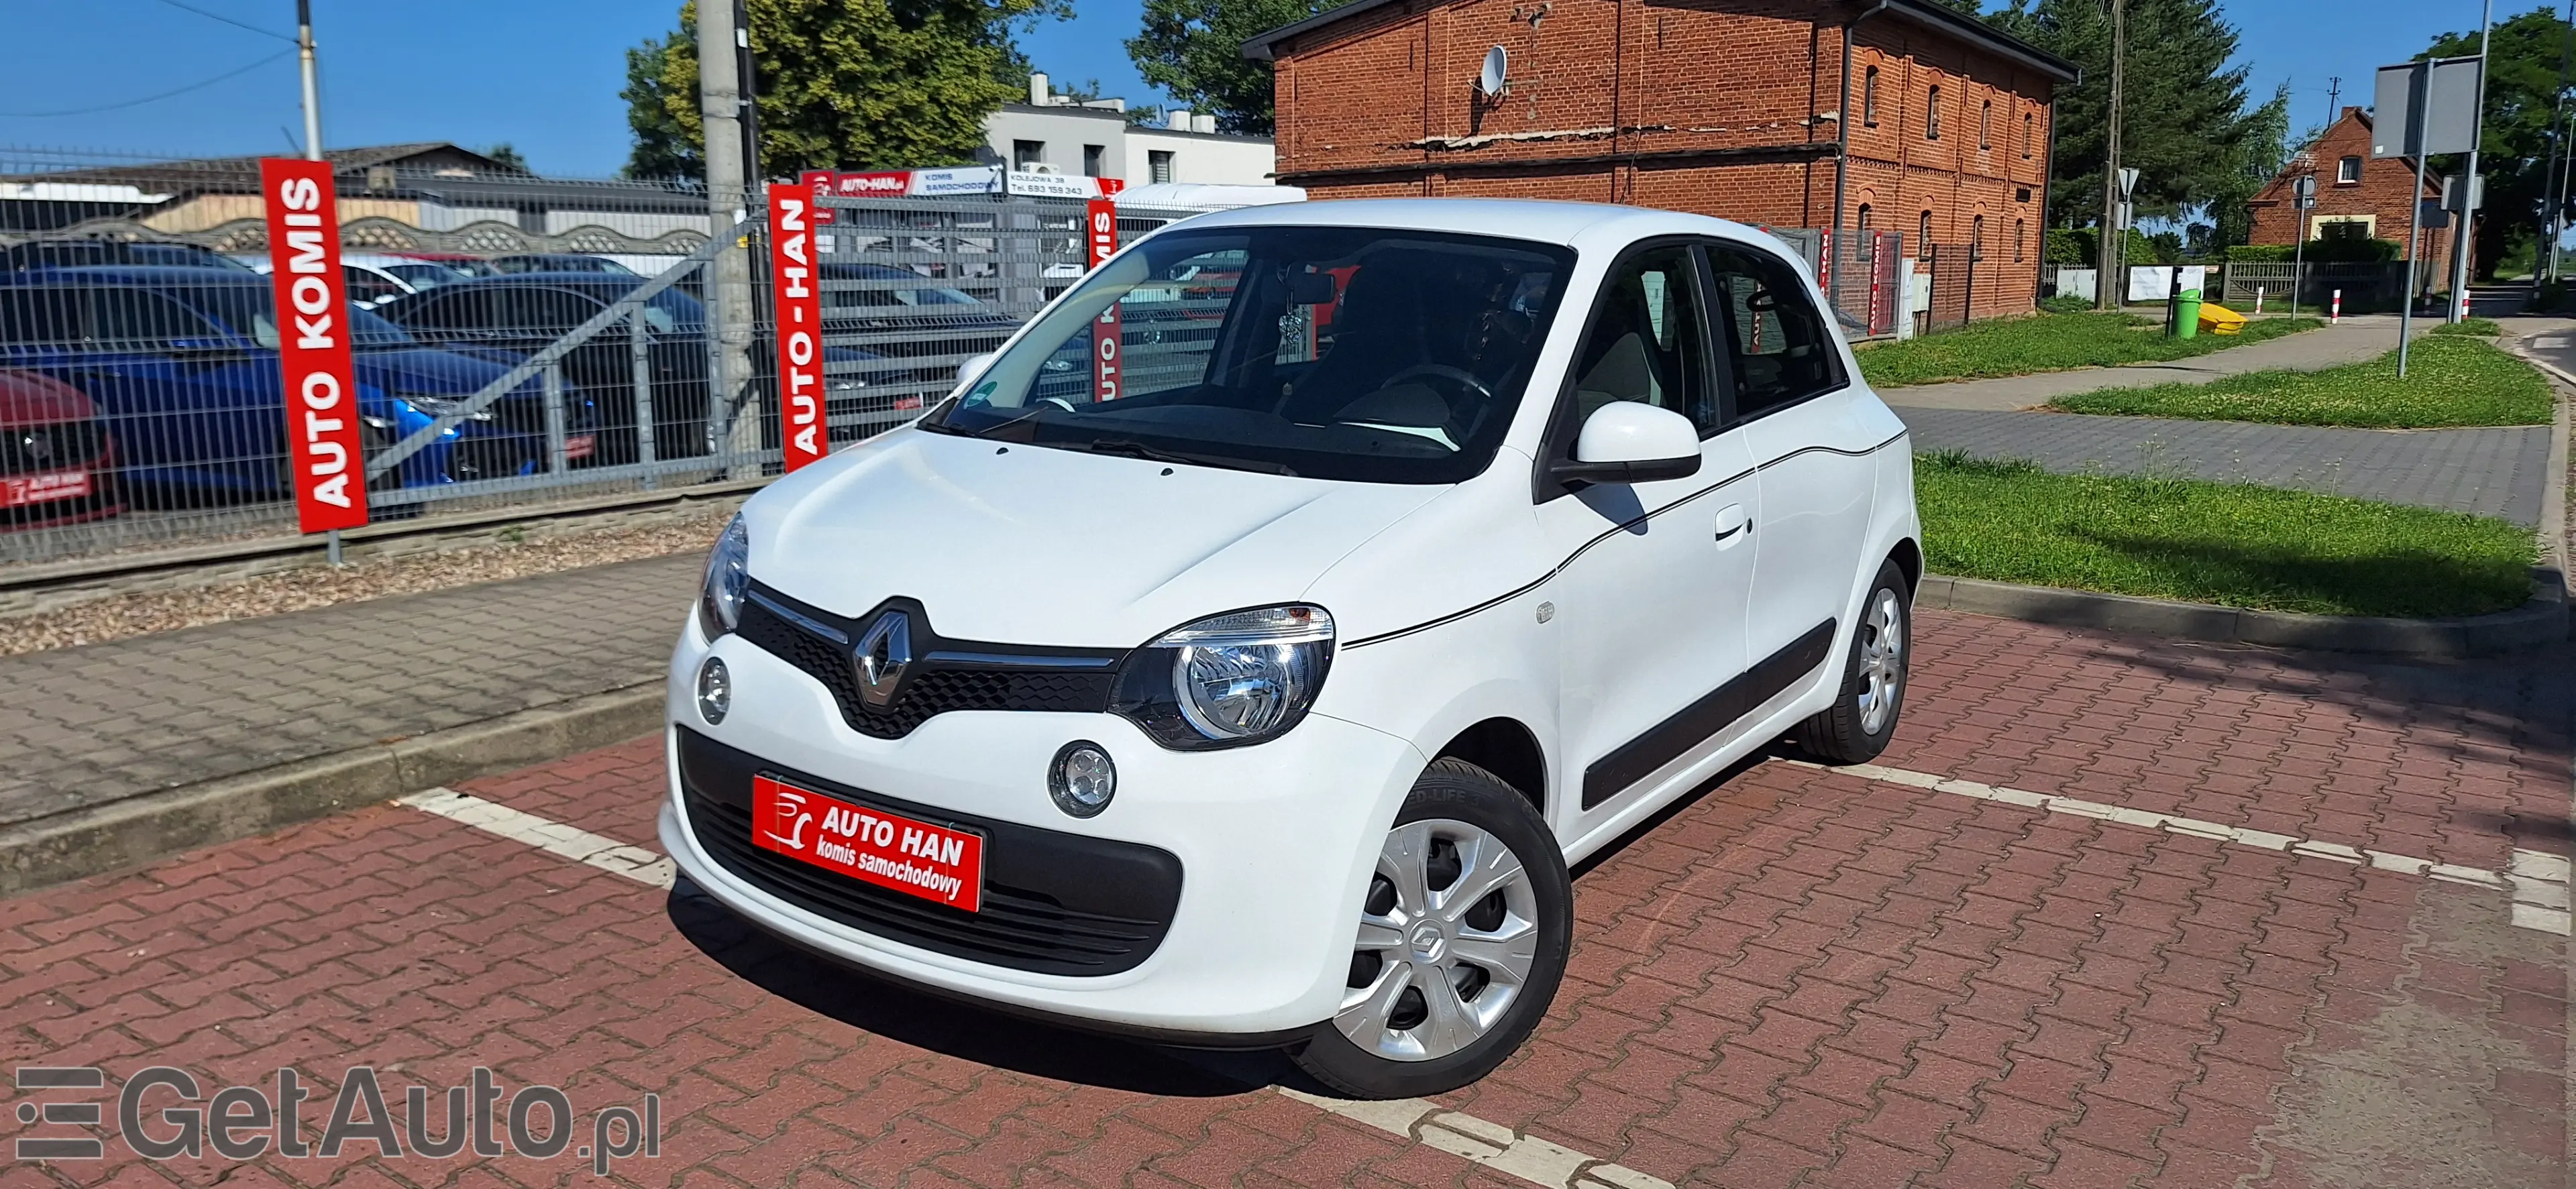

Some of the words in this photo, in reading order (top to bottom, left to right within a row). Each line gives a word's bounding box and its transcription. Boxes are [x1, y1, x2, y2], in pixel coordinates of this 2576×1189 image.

[925, 173, 953, 181] KOMIS
[1011, 175, 1051, 183] KOLEJOWA
[1028, 185, 1046, 193] 693
[280, 177, 335, 349] KOMIS
[1100, 337, 1116, 401] UTO
[302, 371, 352, 509] AUTO
[821, 806, 894, 847] AUTO
[900, 826, 964, 866] HAN
[816, 834, 856, 866] komis
[858, 852, 962, 901] samochodowy
